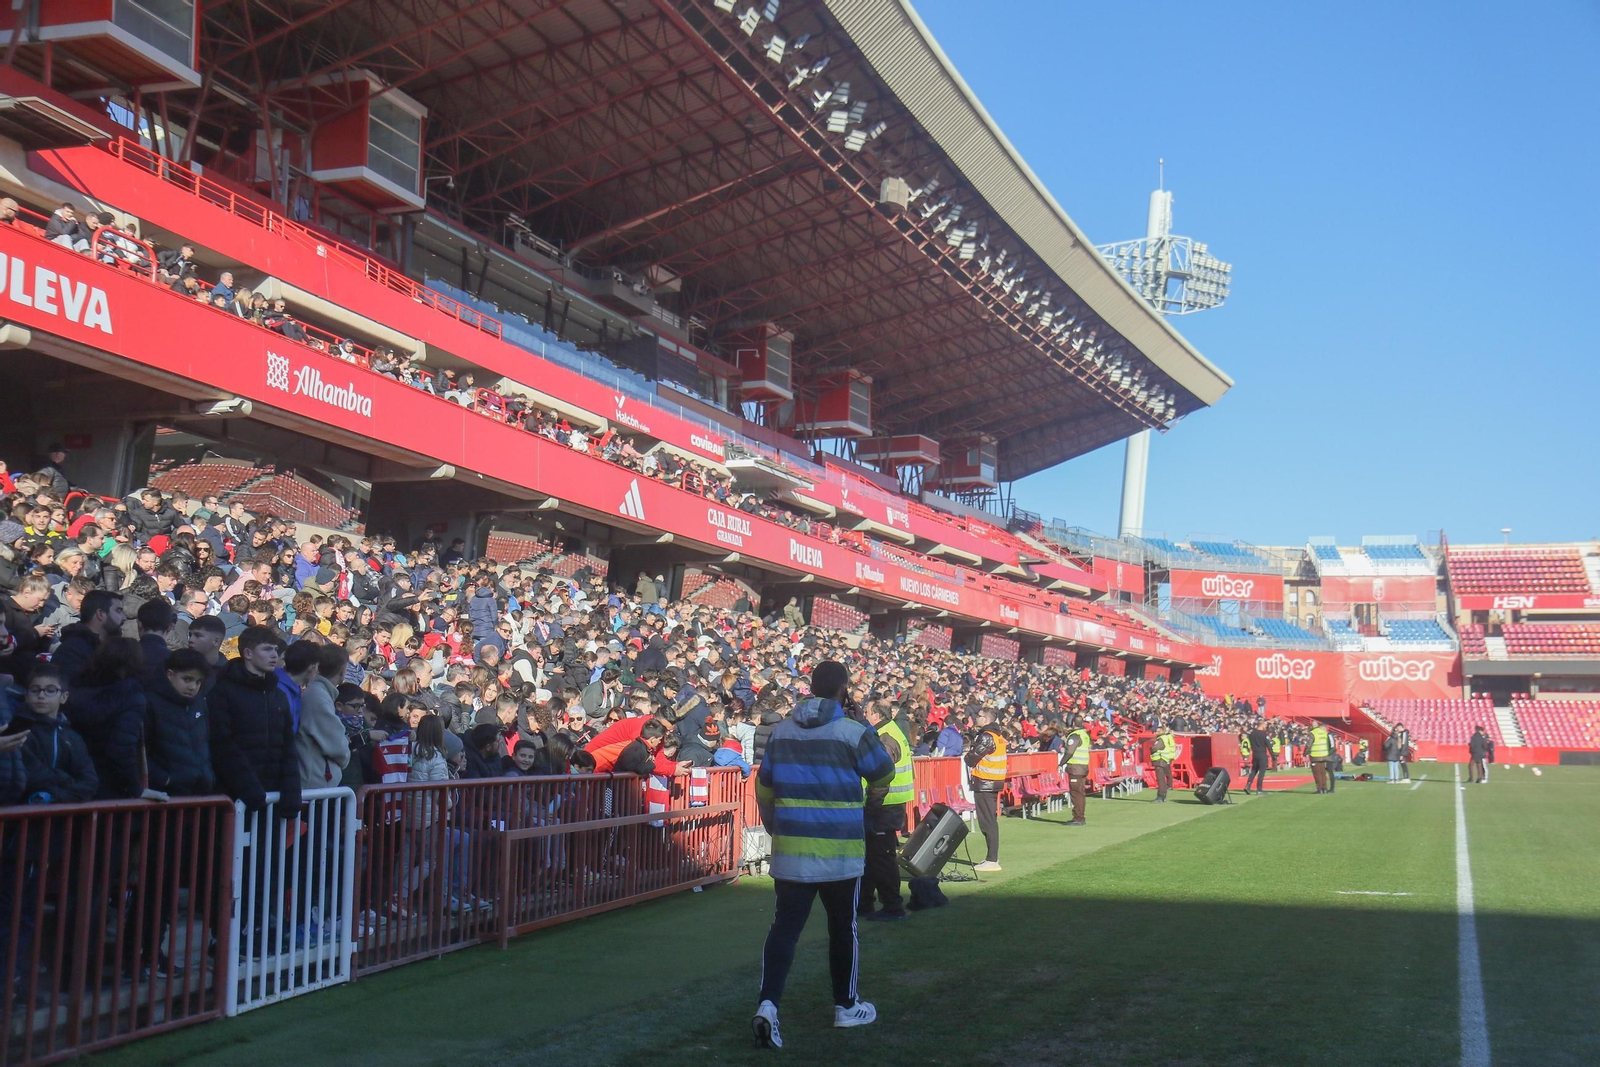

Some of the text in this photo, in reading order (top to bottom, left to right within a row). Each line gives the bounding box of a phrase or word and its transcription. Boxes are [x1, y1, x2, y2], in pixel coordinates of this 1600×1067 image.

[293, 365, 373, 418] Alhambra
[615, 409, 639, 428] Halcón
[707, 508, 752, 536] CAJA RURAL
[716, 529, 743, 547] GRANADA
[789, 538, 823, 568] PULEVA
[900, 576, 959, 605] NUEVO LOS CÁRMENES
[1202, 574, 1253, 598] wiber
[1493, 596, 1535, 609] HSN
[1256, 653, 1315, 680] wiber
[1359, 655, 1435, 681] wiber
